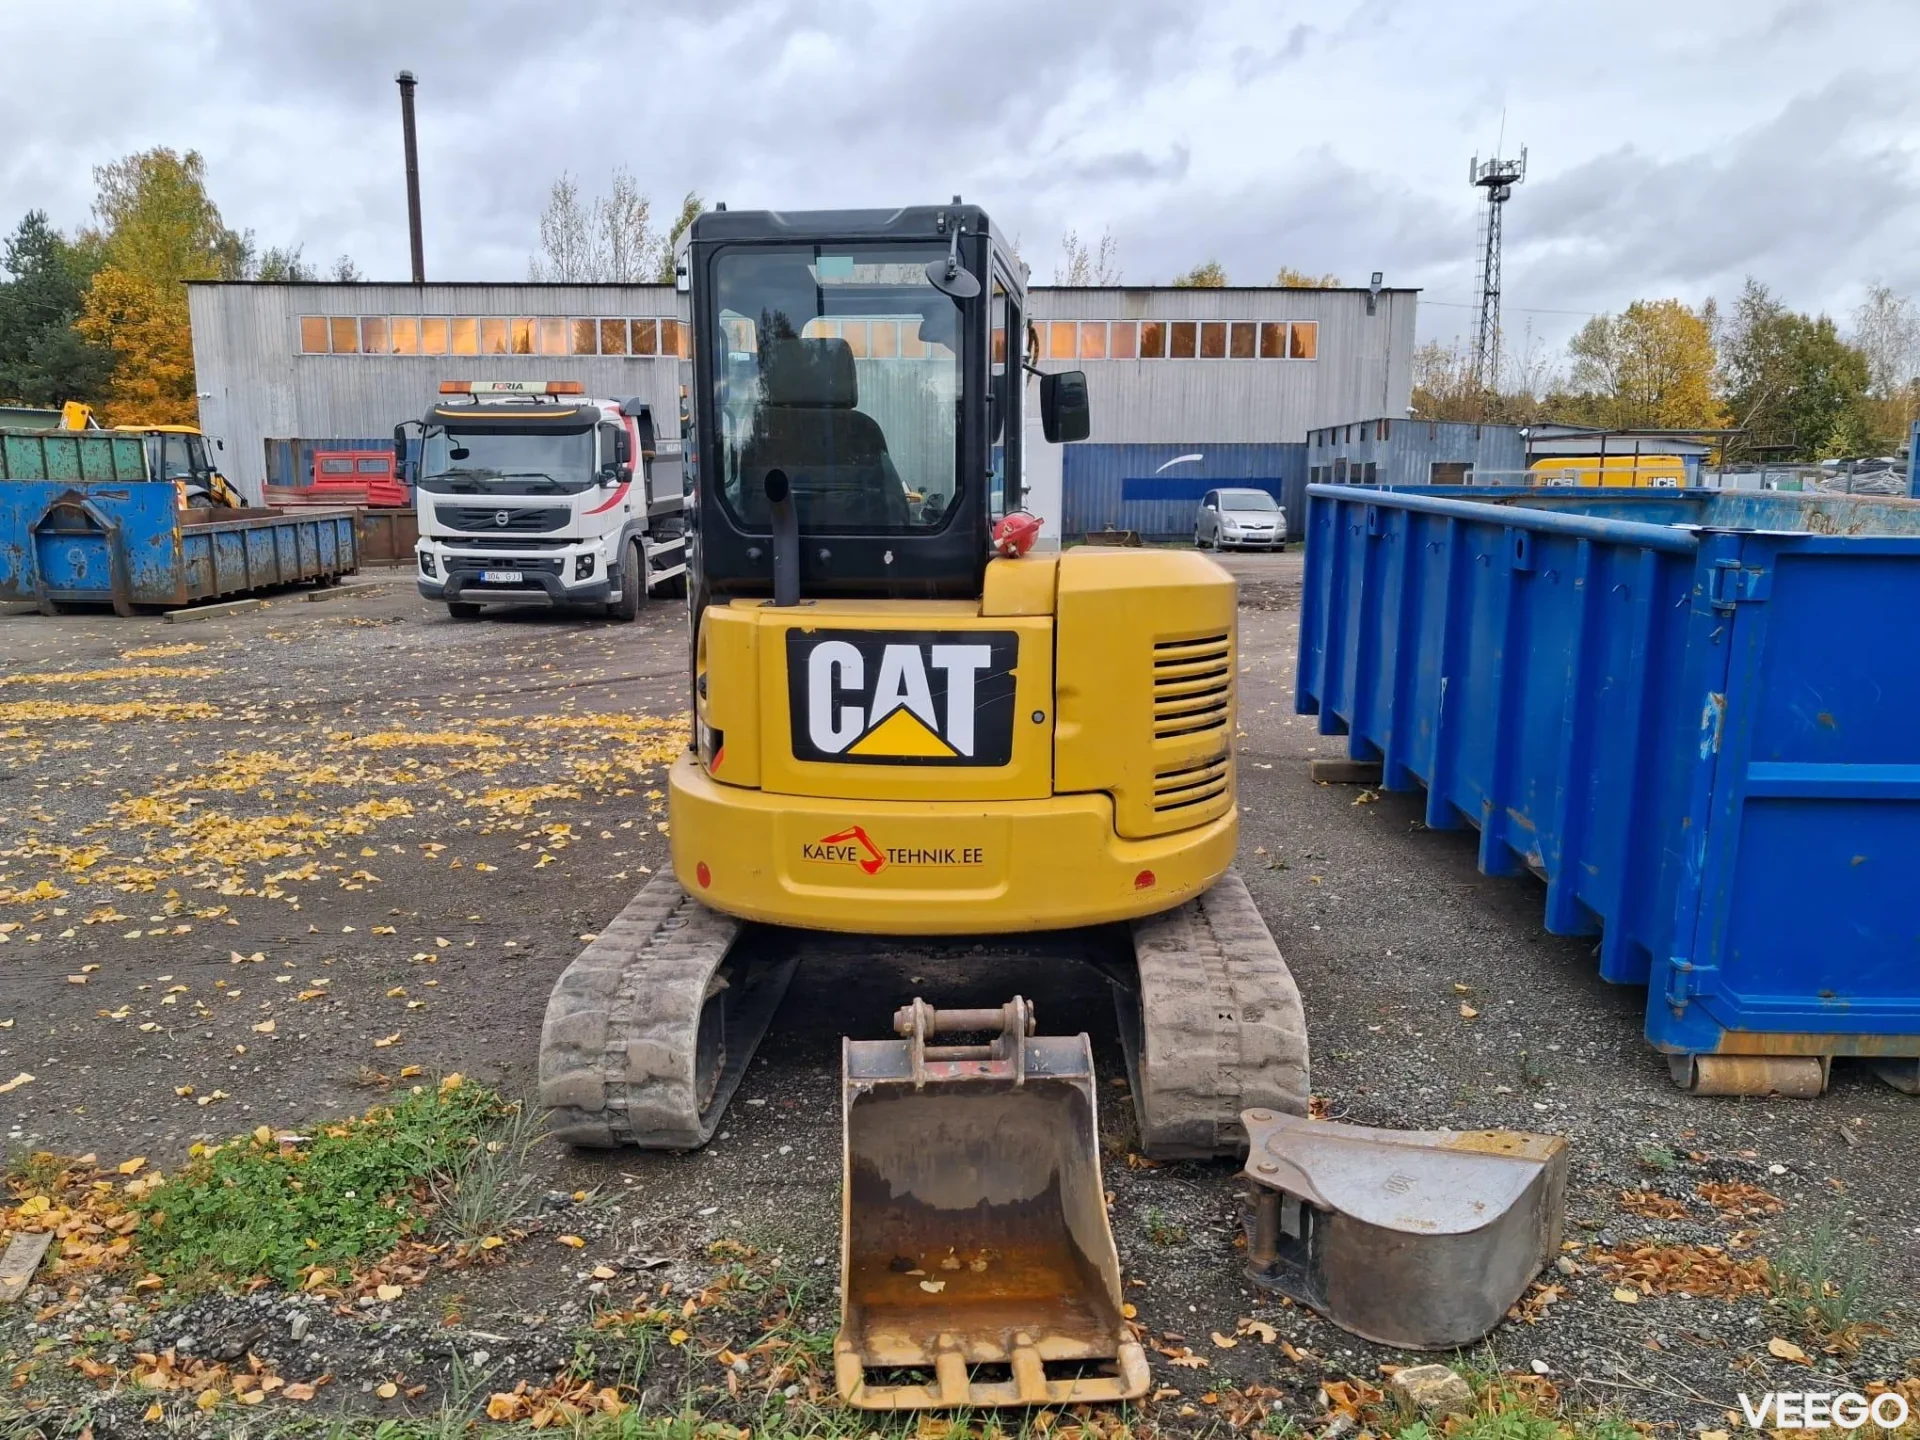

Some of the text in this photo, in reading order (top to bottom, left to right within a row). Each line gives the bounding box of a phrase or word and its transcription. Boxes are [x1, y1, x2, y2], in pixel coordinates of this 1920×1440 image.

[491, 382, 524, 390] FORIA
[486, 572, 500, 580] 304
[808, 640, 991, 757] CAT
[803, 843, 983, 864] KAEVE TEHNIK.EE
